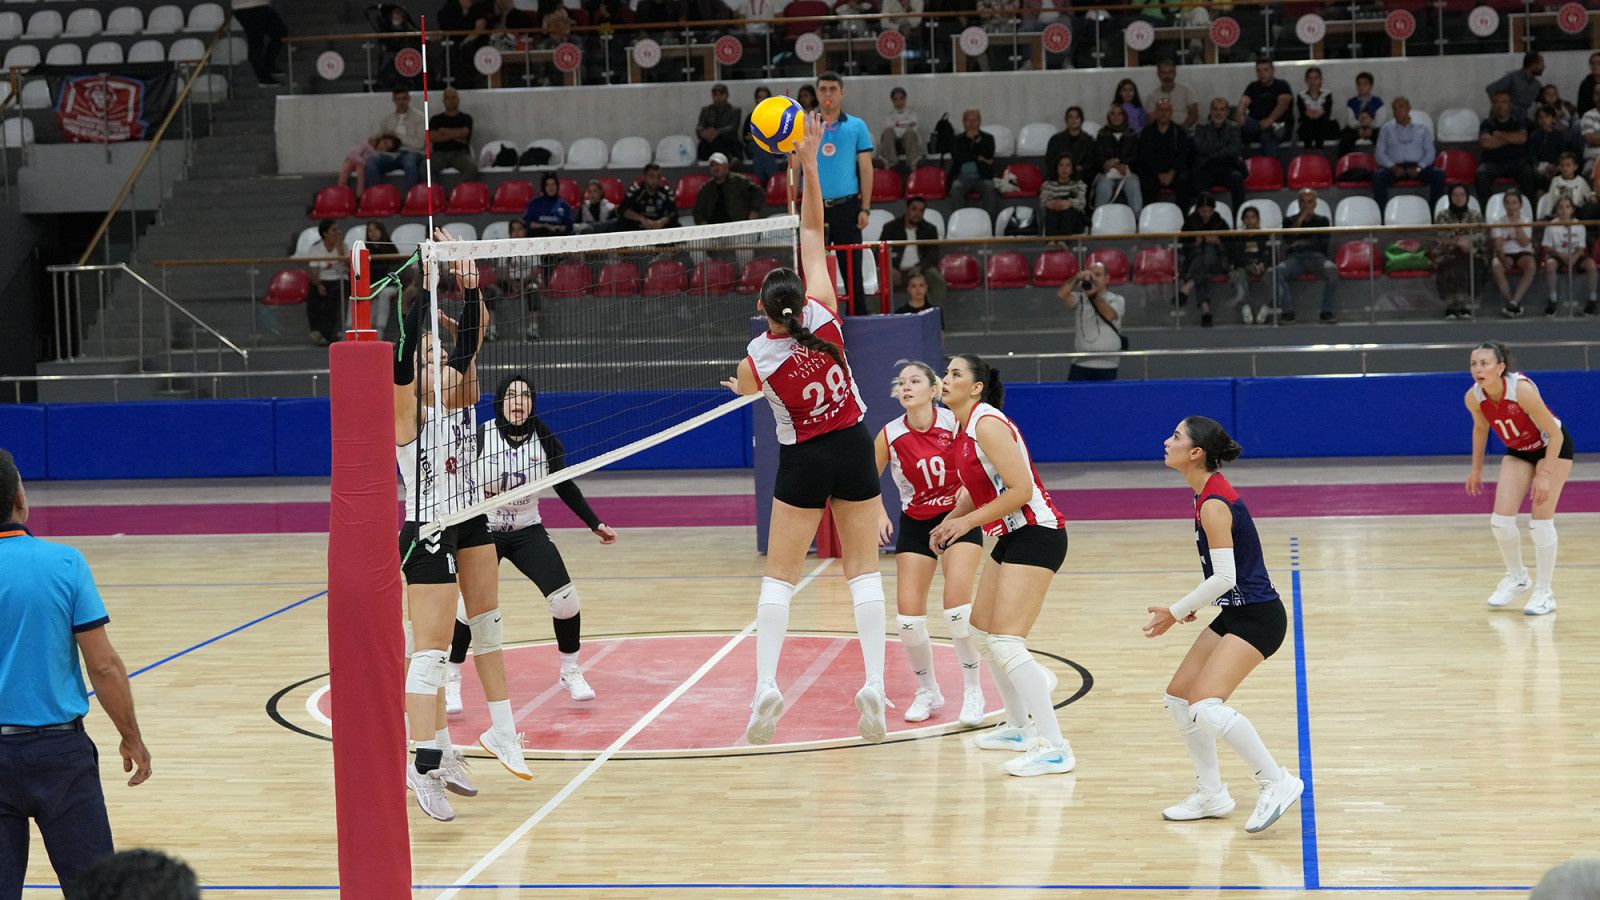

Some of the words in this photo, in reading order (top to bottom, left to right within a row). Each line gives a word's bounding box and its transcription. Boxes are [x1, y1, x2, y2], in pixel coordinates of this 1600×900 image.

[787, 351, 826, 381] MARKA
[801, 357, 829, 379] OTEL
[802, 364, 847, 417] 28
[1494, 418, 1520, 440] 11
[916, 456, 946, 490] 19
